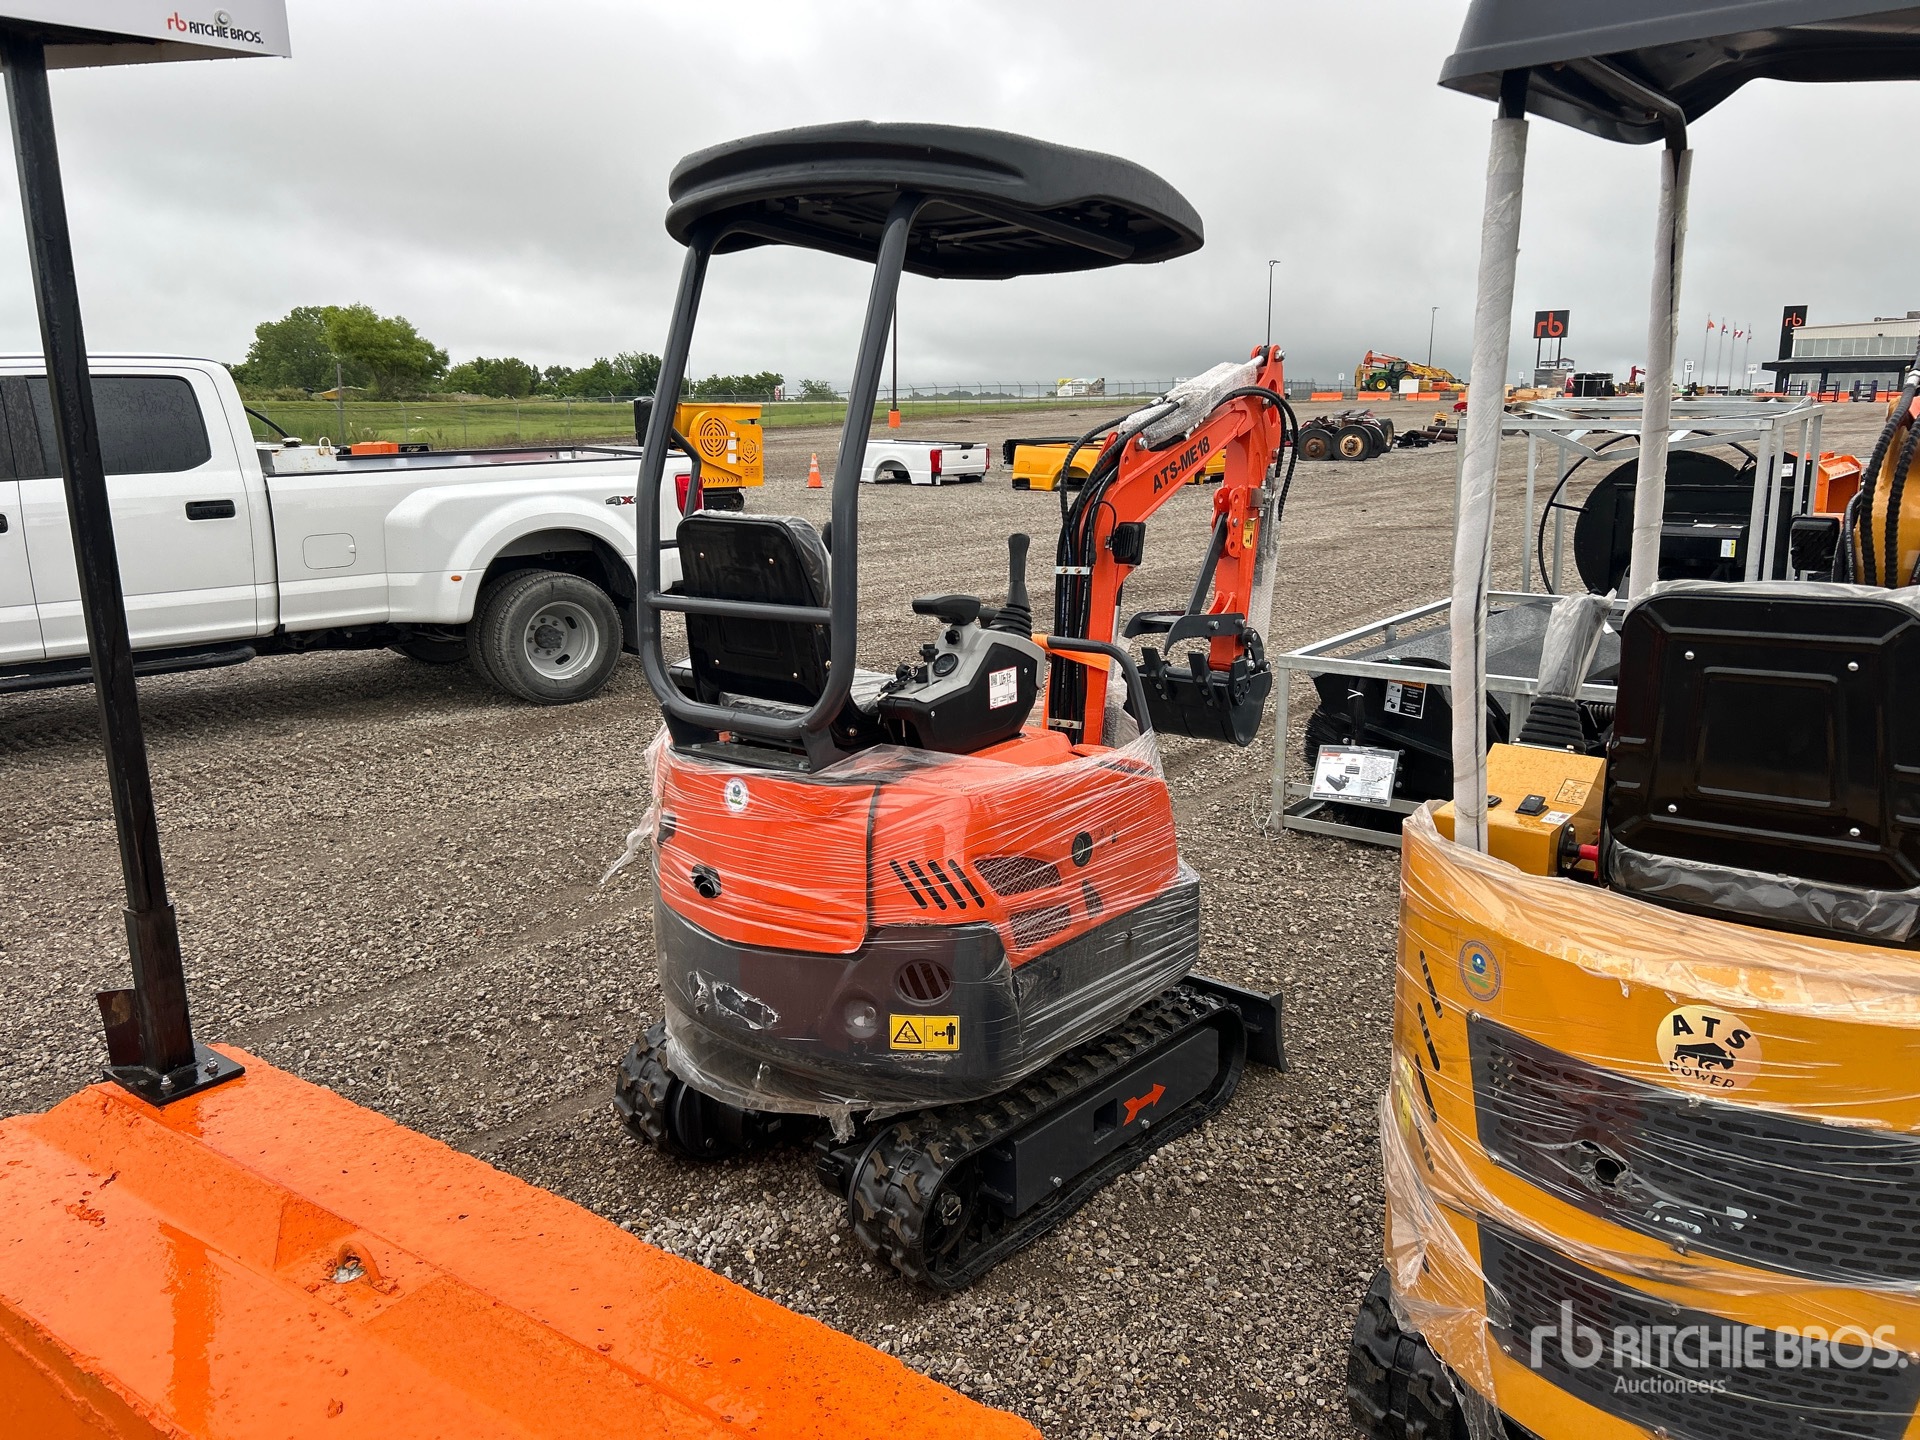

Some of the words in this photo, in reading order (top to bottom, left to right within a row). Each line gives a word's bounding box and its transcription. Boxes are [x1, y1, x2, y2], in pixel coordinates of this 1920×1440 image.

[167, 12, 187, 32] rb
[189, 21, 228, 39] RITCHIE
[230, 28, 264, 44] BROS.
[1536, 312, 1564, 337] rb
[1785, 312, 1803, 327] rb
[1153, 436, 1210, 494] ATS-ME18
[1672, 1014, 1751, 1049] ATS
